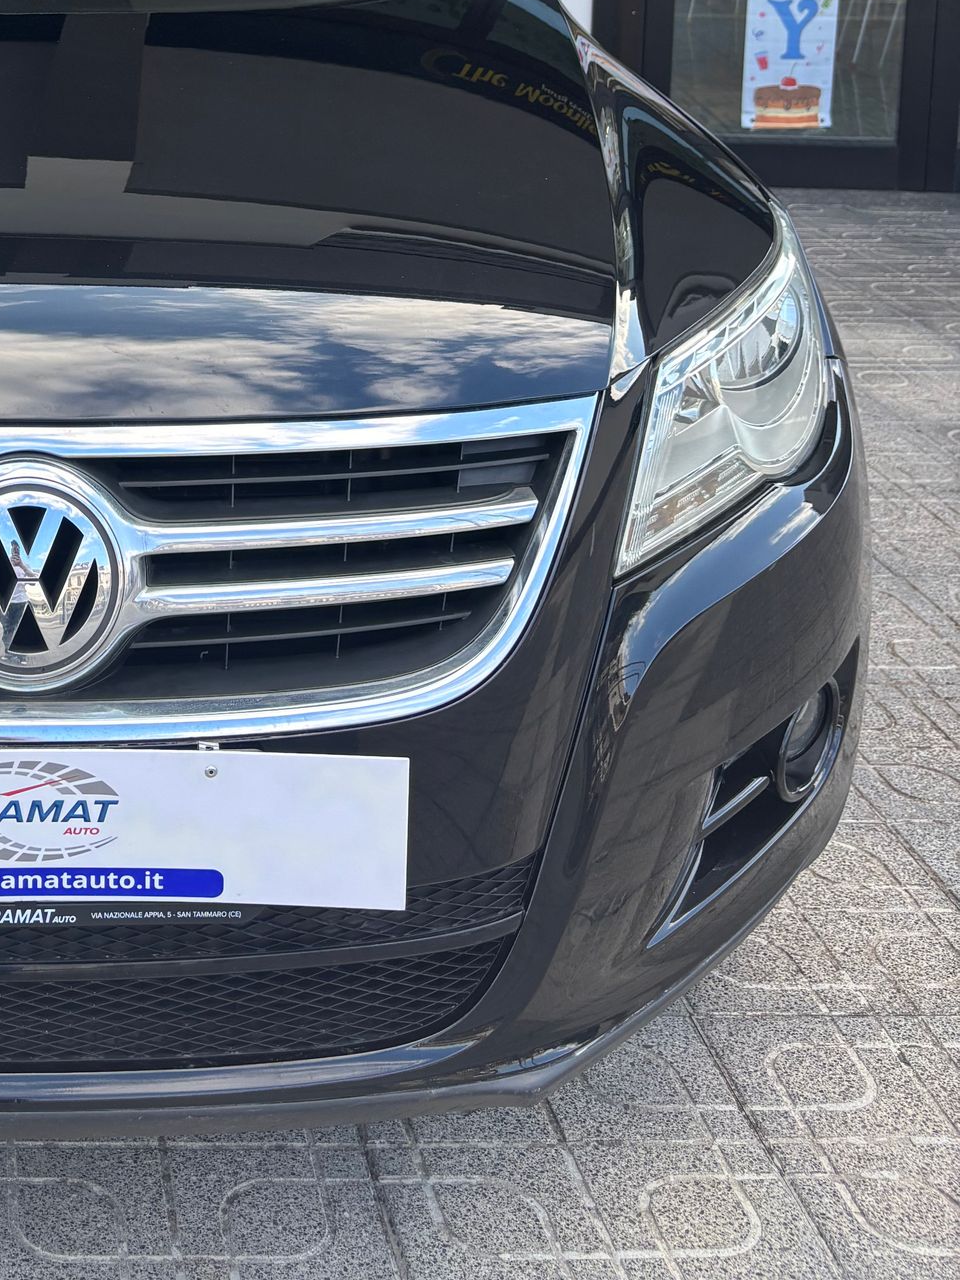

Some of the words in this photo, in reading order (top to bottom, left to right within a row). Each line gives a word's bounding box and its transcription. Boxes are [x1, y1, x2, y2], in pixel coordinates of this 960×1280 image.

[63, 827, 100, 836] AUTO
[52, 915, 77, 923] AUTO
[144, 911, 166, 919] APPIA,
[228, 910, 242, 919] (CE)
